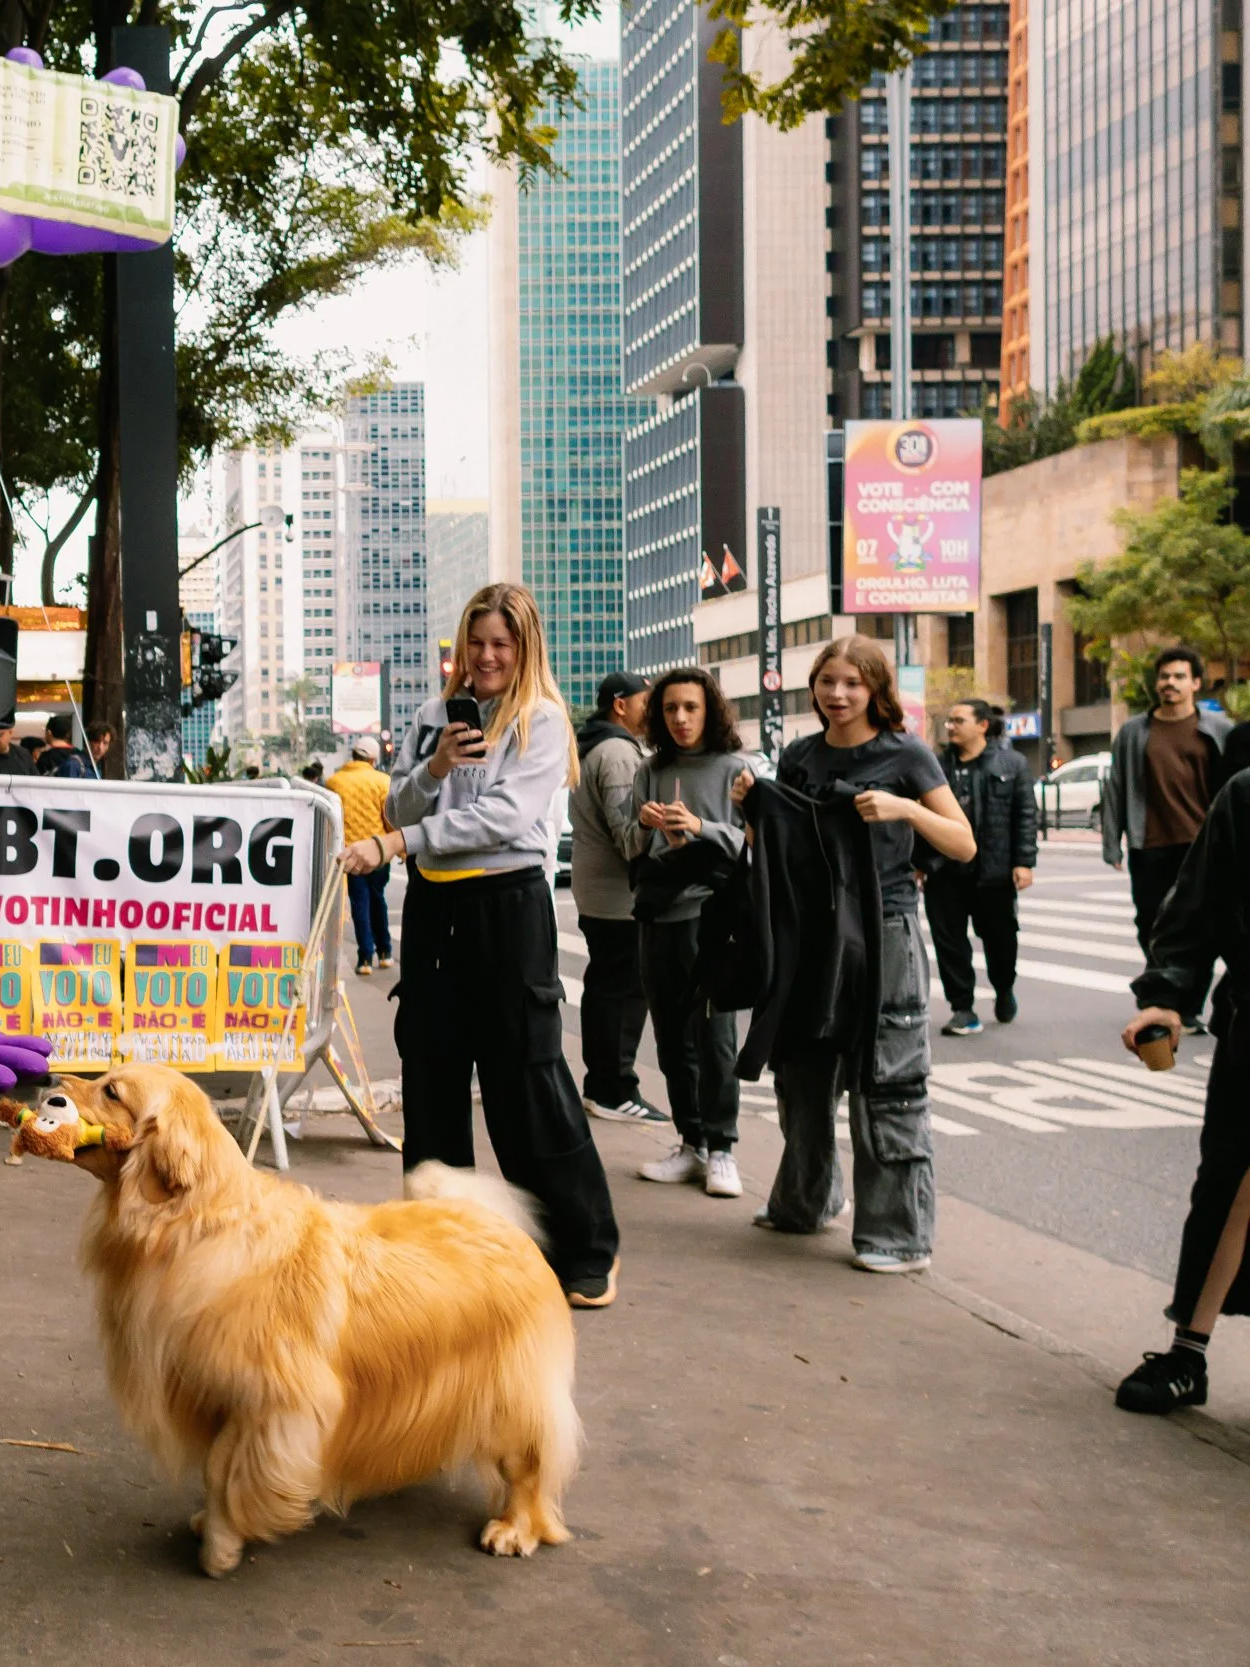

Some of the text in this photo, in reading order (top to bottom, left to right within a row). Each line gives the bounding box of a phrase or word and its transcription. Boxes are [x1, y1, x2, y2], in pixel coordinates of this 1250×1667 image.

[857, 480, 970, 497] VOTE COM
[857, 494, 970, 513] CONSCIÊNCIA
[856, 538, 878, 557] 07
[940, 539, 969, 557] 10H
[764, 534, 777, 586] Azevedo
[932, 575, 969, 590] LUTA
[765, 587, 778, 626] Rocha
[855, 591, 968, 606] E CONQUISTAS
[61, 943, 112, 966] MEU
[157, 944, 208, 967] MEU
[251, 945, 300, 969] MEU
[39, 970, 113, 1008] VOTO
[134, 971, 208, 1007] VOTO
[228, 971, 298, 1008] VOTO
[6, 1012, 21, 1030] É
[42, 1010, 113, 1029] NÃO É
[133, 1011, 207, 1029] NÃO É
[224, 1011, 269, 1029] NÃO
